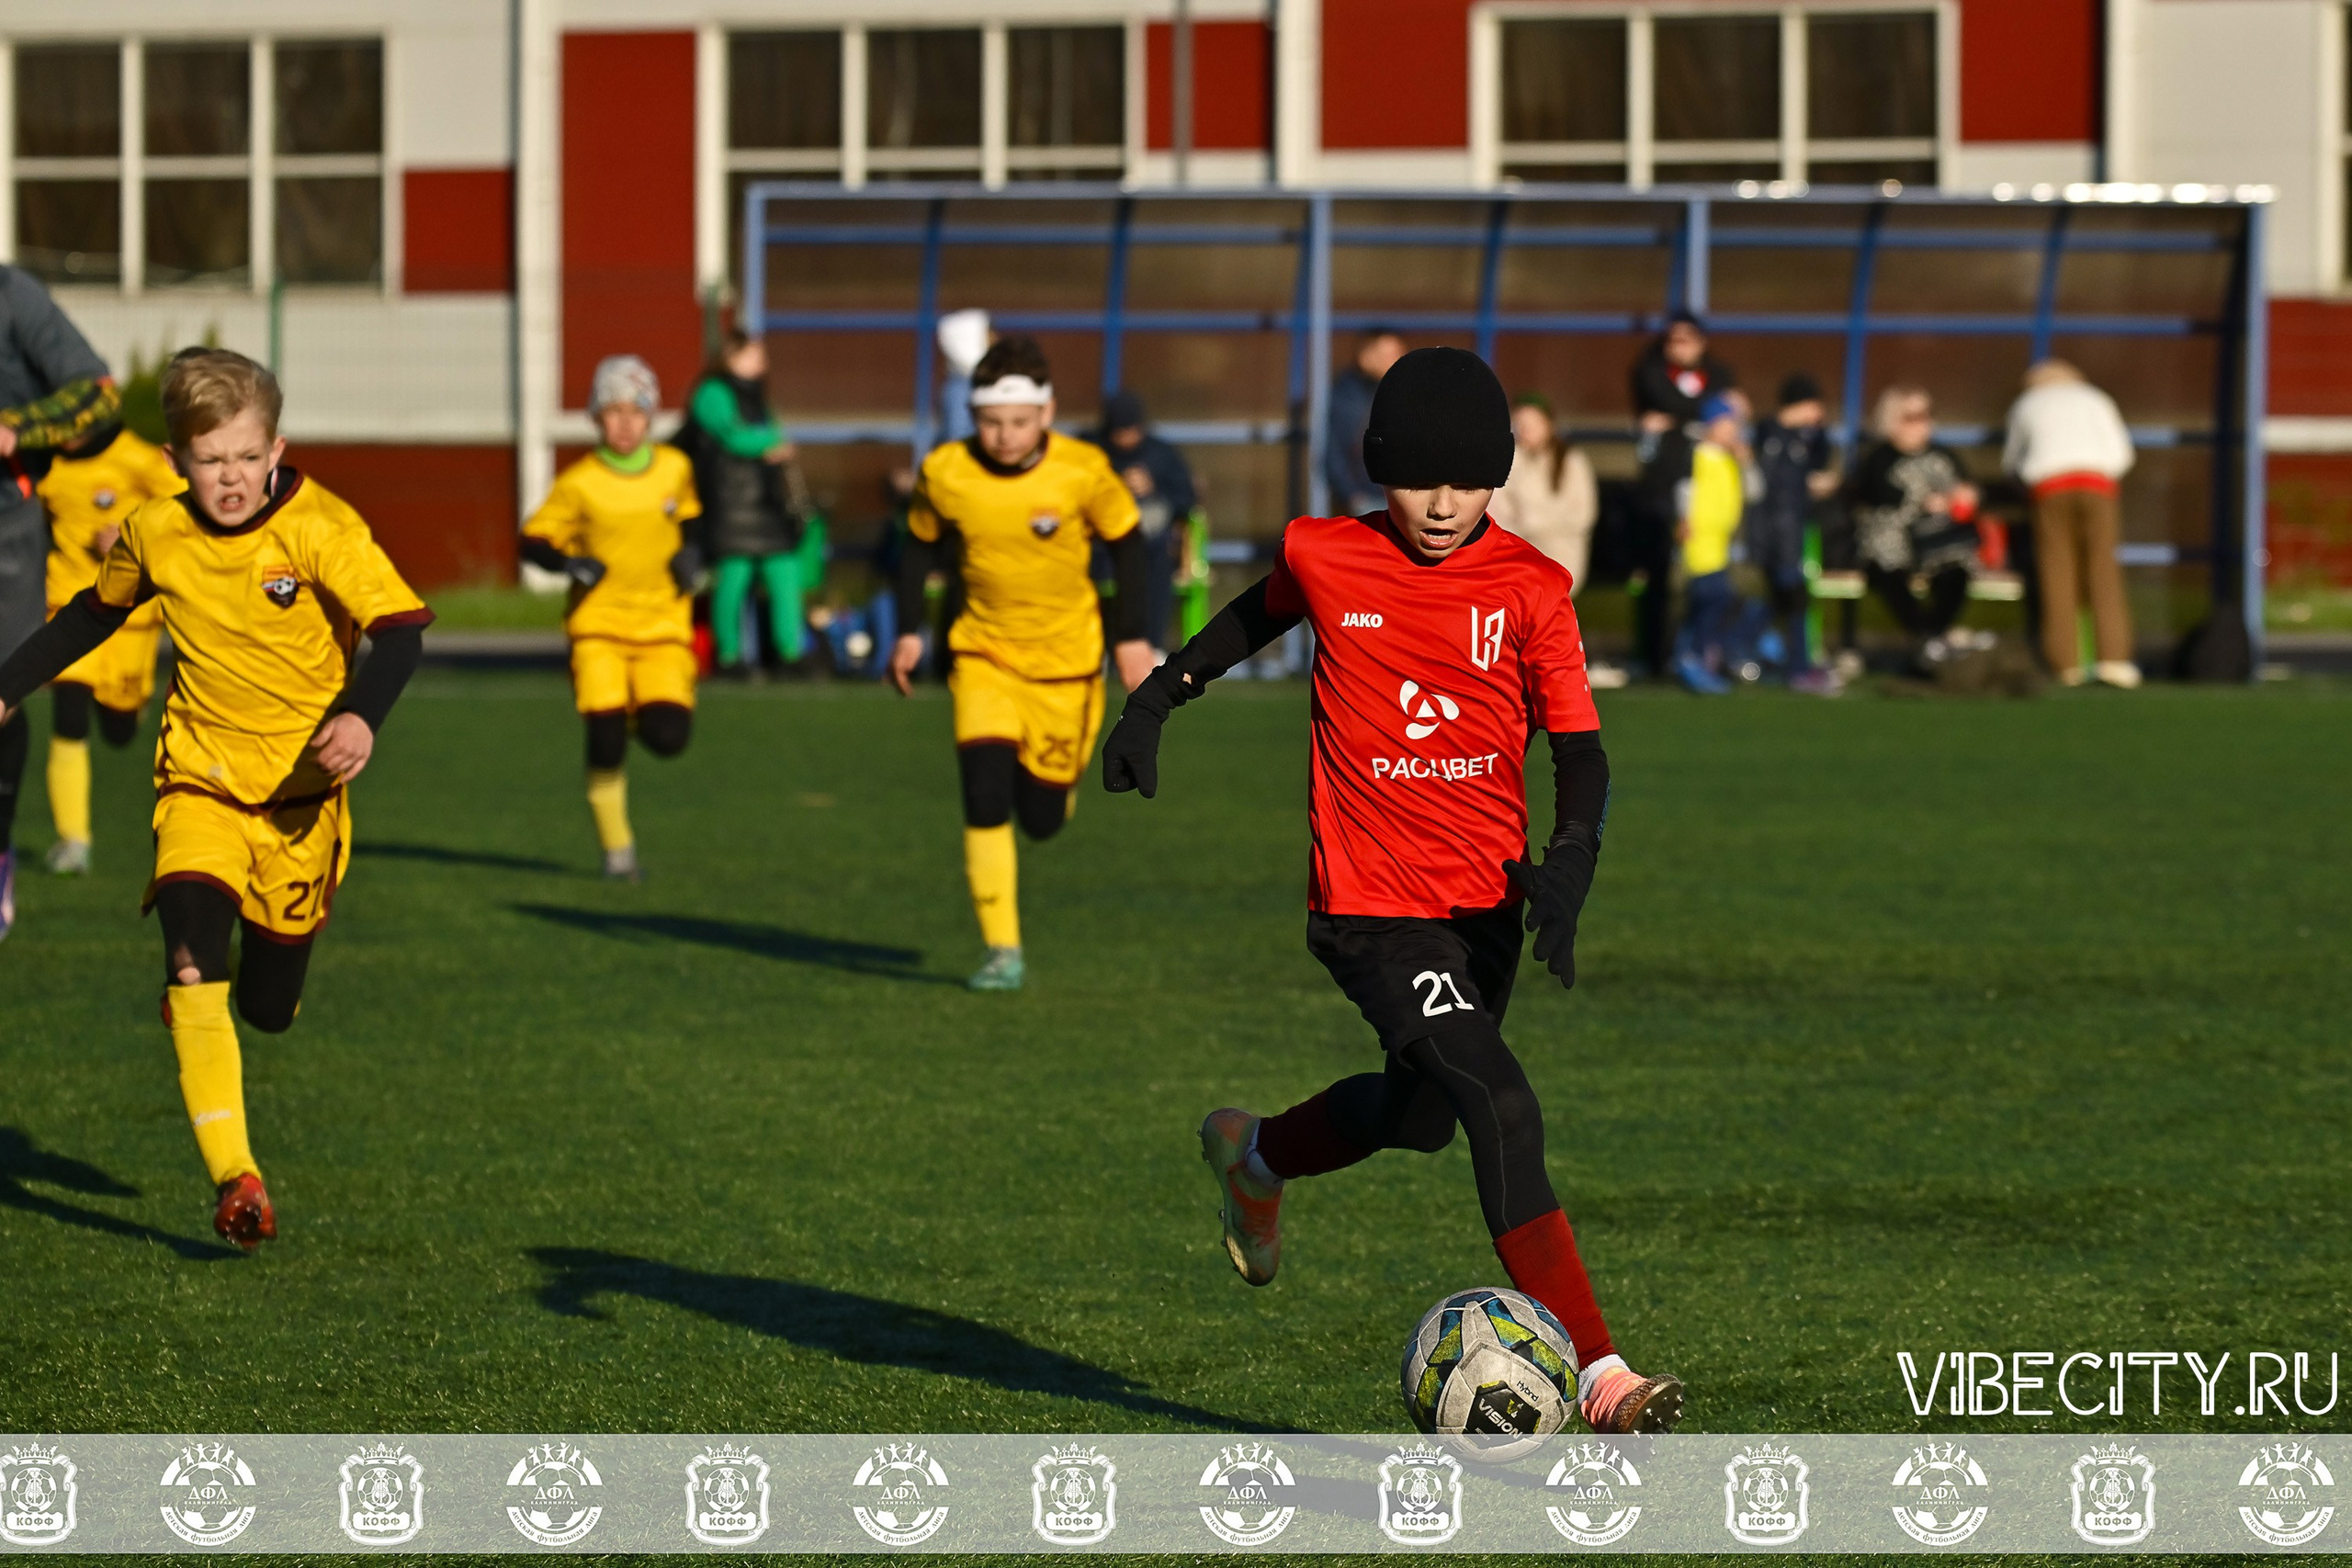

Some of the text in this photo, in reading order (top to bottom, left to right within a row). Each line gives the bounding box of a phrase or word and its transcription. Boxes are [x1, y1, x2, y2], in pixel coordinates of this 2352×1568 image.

[1340, 613, 1384, 628] JAKO
[1372, 752, 1499, 782] РАСЦВЕТ
[1411, 970, 1476, 1018] 21
[1516, 1381, 1539, 1402] Hybrid
[1478, 1398, 1523, 1439] VISION
